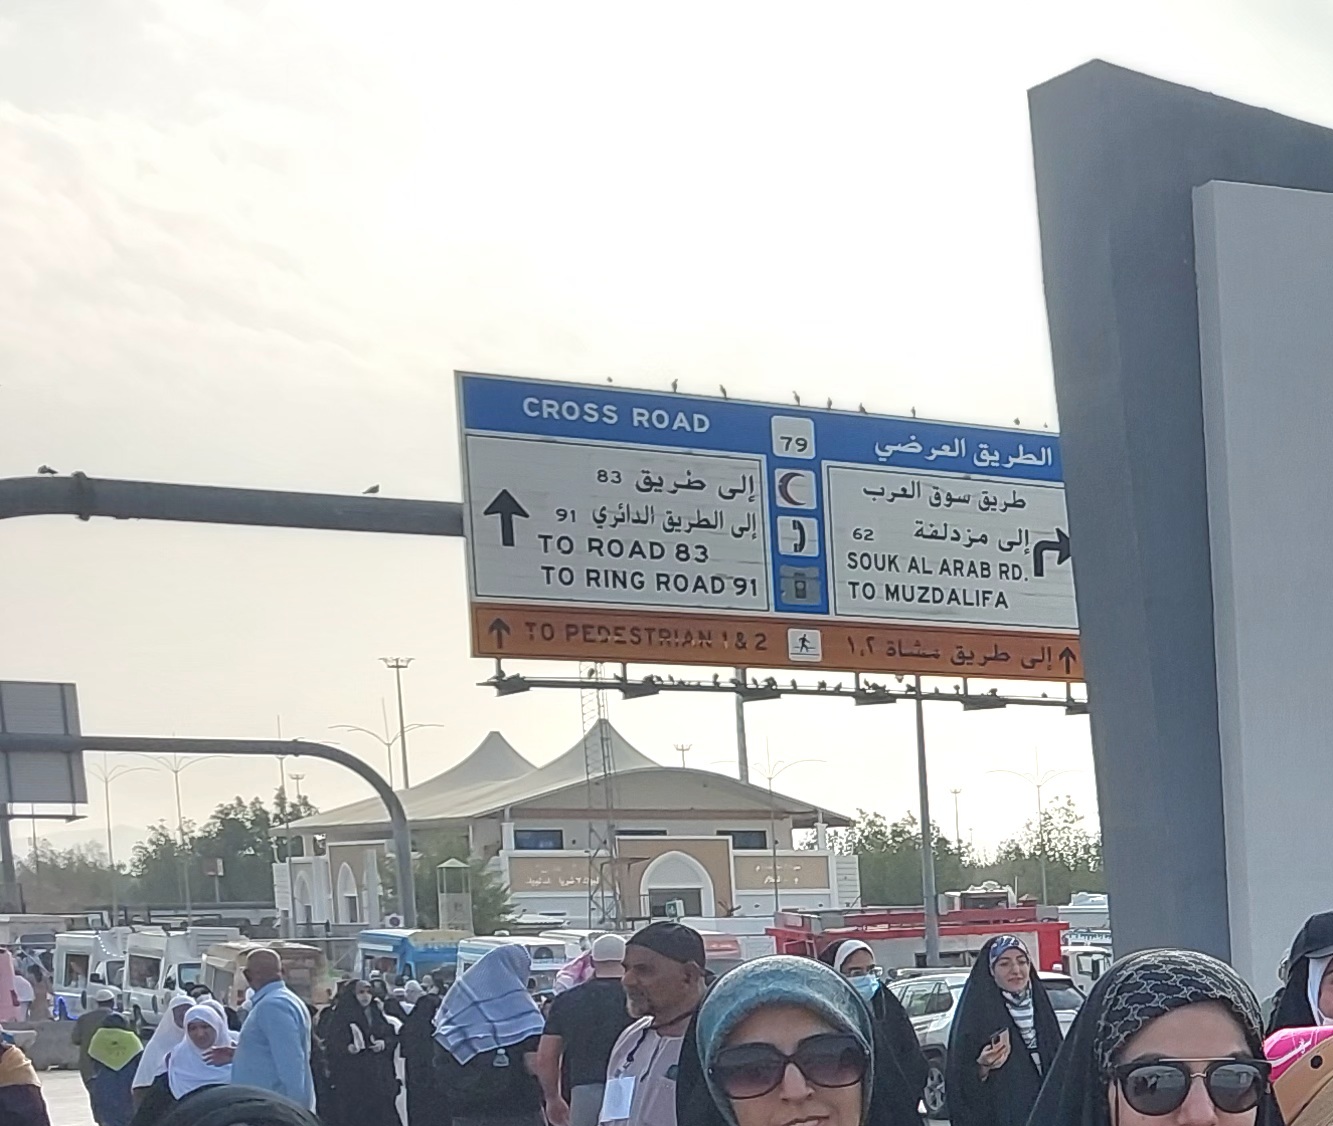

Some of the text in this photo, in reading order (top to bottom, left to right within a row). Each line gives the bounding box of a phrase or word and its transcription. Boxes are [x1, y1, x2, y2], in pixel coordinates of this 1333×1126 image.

[522, 397, 711, 433] CROSS ROAD
[779, 436, 809, 453] 79
[874, 435, 1052, 468] الطريق العرضي
[597, 469, 622, 484] 83
[719, 474, 755, 502] إلى
[863, 481, 1027, 512] طريق سوق العرب
[555, 508, 576, 523] 91
[592, 503, 655, 529] الدائري
[662, 508, 724, 533] الطريق
[538, 535, 710, 563] TO ROAD 83
[852, 520, 1030, 556] إلى مزدلفة 62
[847, 552, 1029, 582] SOUK AL ARAB RD.
[541, 566, 758, 597] TO RING ROAD 91
[847, 581, 1009, 609] TO MUZDALIFA
[525, 622, 555, 641] TO
[566, 624, 713, 648] PEDESTRIAN
[950, 643, 1012, 666] طريق
